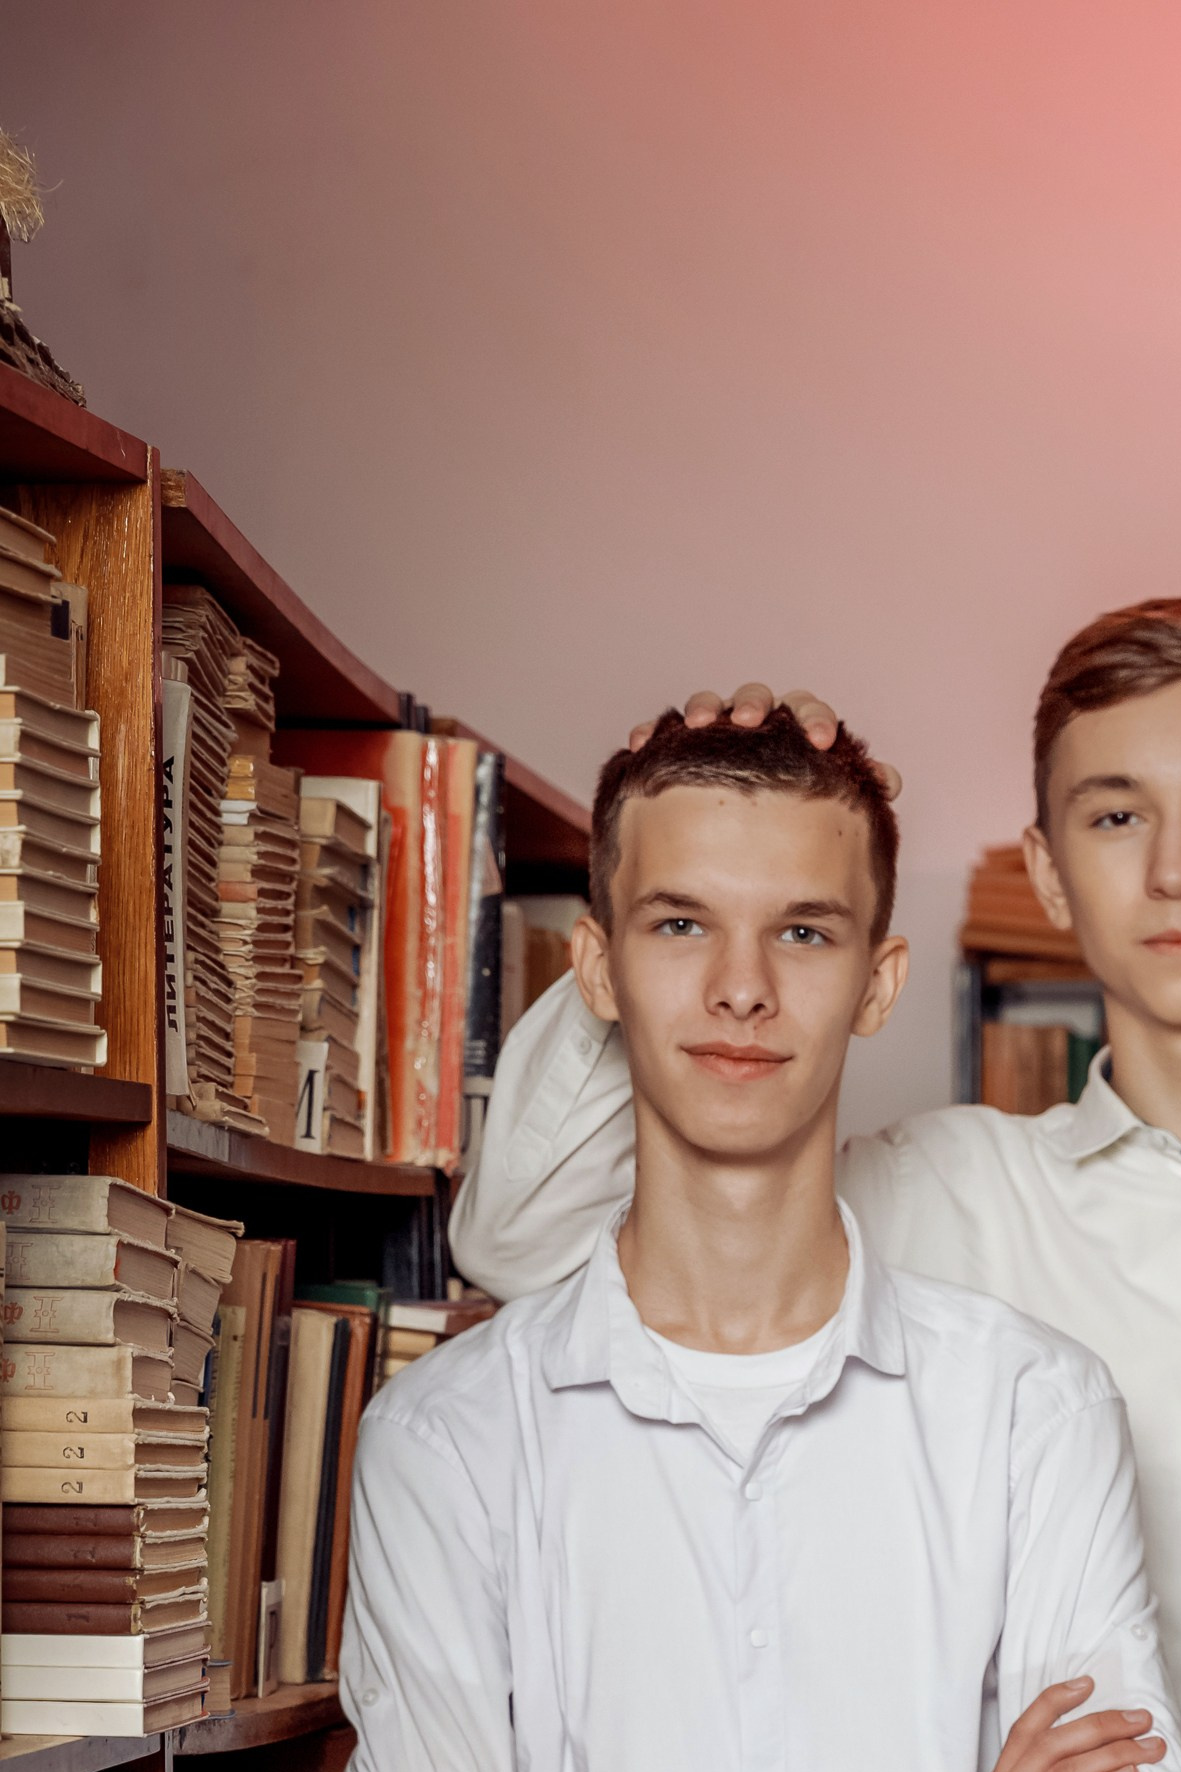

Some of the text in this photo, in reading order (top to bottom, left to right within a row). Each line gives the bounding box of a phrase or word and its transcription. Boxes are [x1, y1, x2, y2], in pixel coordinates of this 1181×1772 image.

[66, 1411, 88, 1424] 2
[63, 1446, 85, 1459] 2
[61, 1481, 83, 1494] 2
